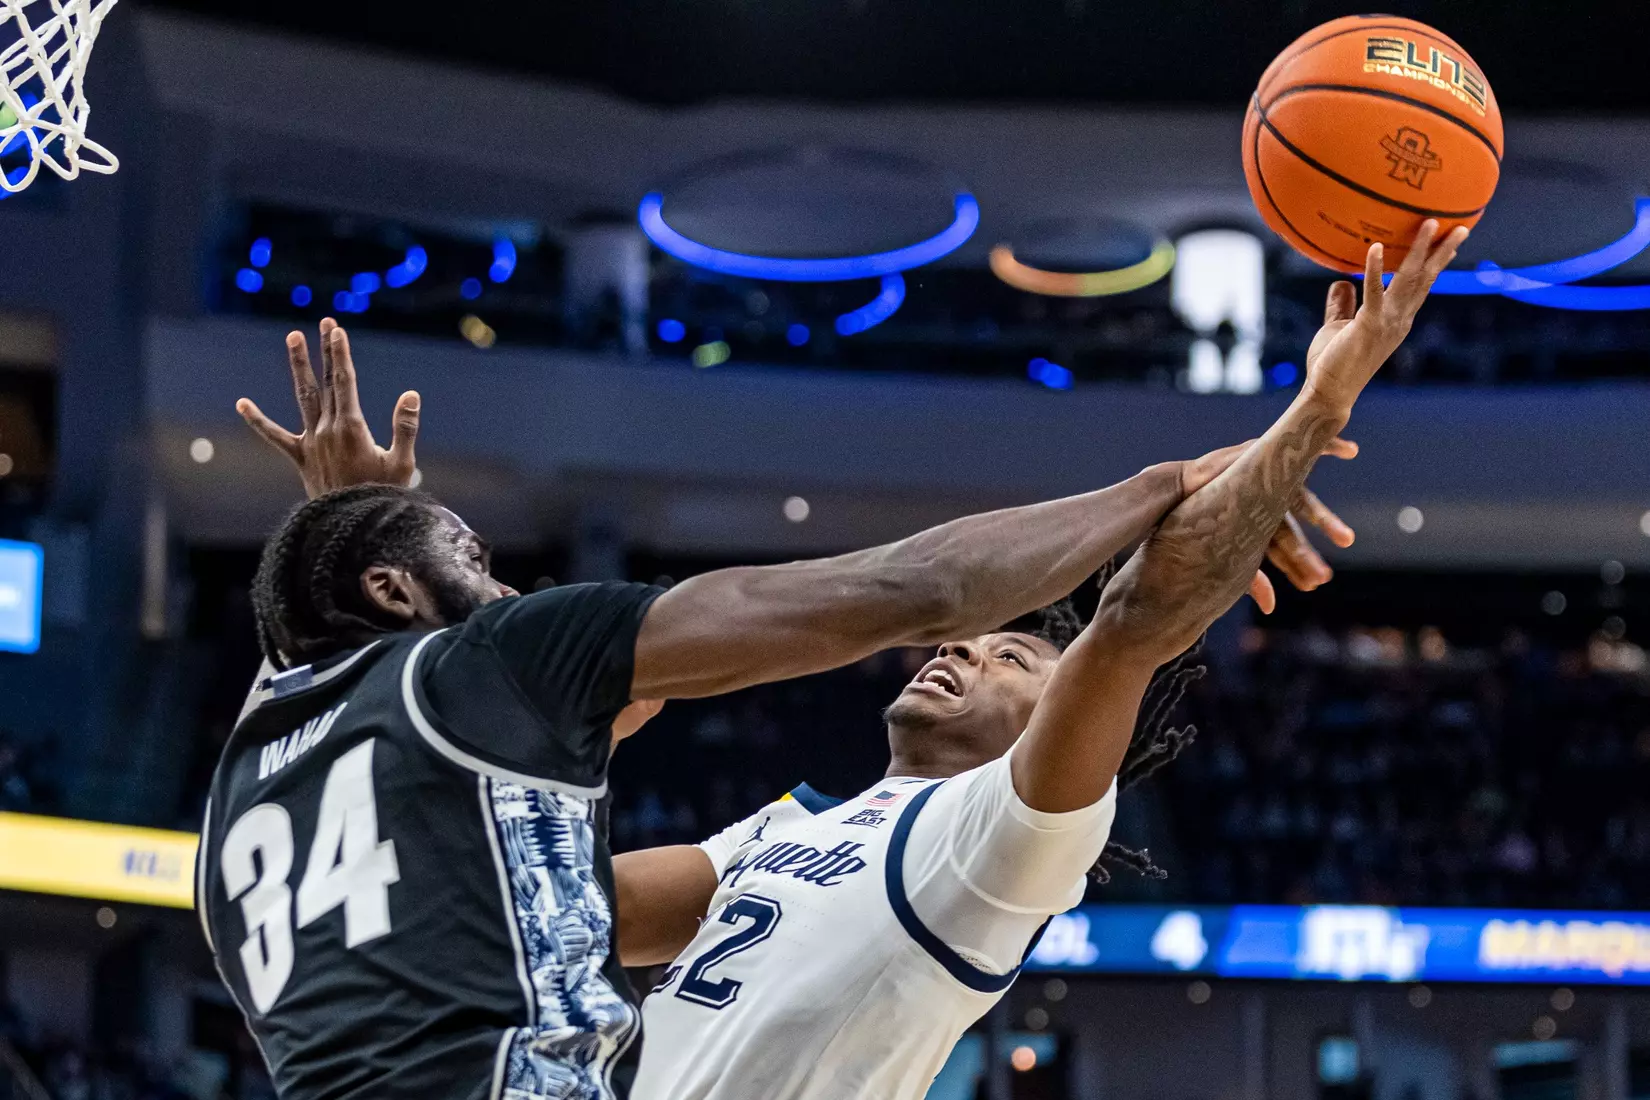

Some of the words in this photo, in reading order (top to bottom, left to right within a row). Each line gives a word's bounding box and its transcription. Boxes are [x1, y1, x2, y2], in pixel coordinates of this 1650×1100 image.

[1365, 36, 1487, 111] ELITE
[846, 815, 888, 826] EAST
[859, 808, 886, 817] BIG
[221, 737, 401, 1015] 34
[650, 892, 783, 1011] 2
[1150, 910, 1208, 971] 4
